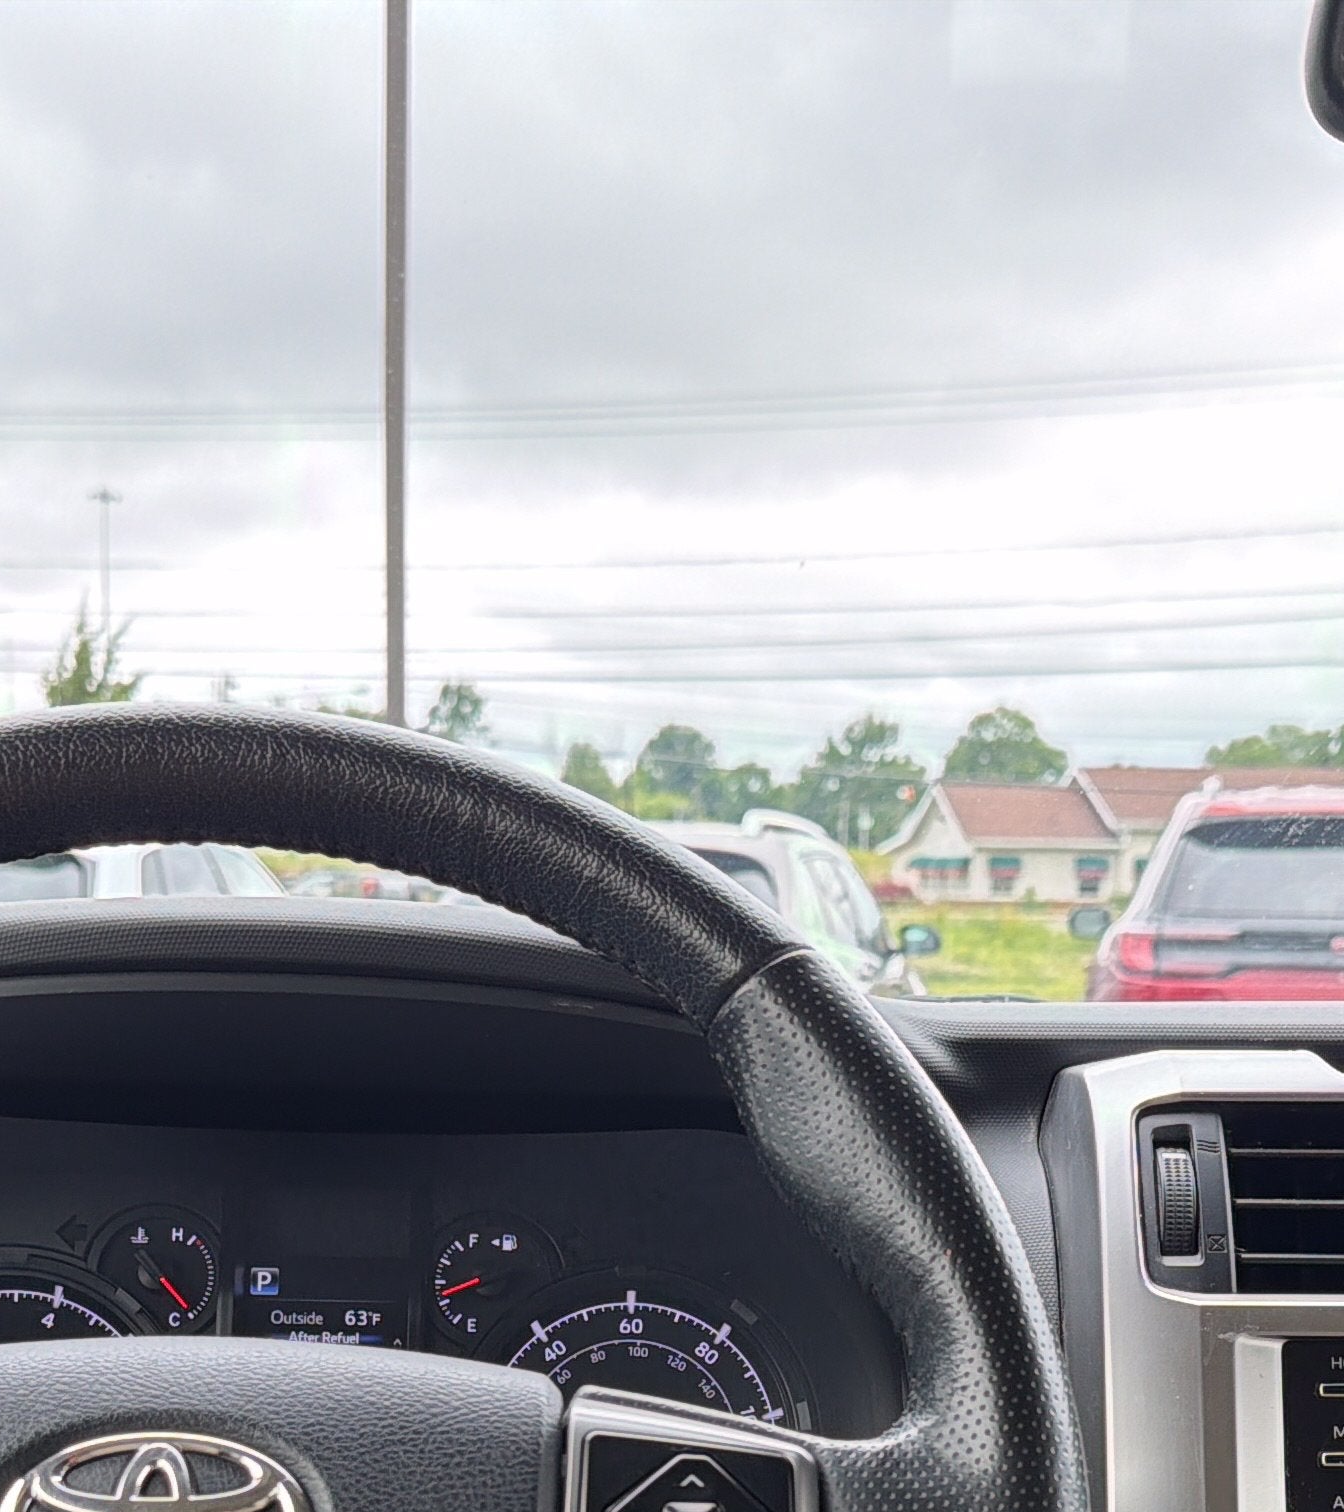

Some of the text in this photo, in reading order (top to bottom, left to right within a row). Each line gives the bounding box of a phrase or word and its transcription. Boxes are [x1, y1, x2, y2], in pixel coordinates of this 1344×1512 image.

[171, 1227, 184, 1242] H
[468, 1233, 480, 1249] F
[257, 1271, 272, 1292] P
[40, 1312, 56, 1329] 4
[168, 1312, 181, 1328] C
[270, 1309, 381, 1326] Outside 63°F
[467, 1318, 477, 1333] E
[619, 1318, 643, 1334] 60
[288, 1331, 360, 1344] After Refuel
[544, 1340, 567, 1362] 40
[590, 1350, 606, 1363] 80
[628, 1346, 649, 1358] 100
[694, 1342, 719, 1365] 80
[666, 1355, 687, 1372] 120
[556, 1369, 572, 1385] 60
[698, 1378, 716, 1399] 140
